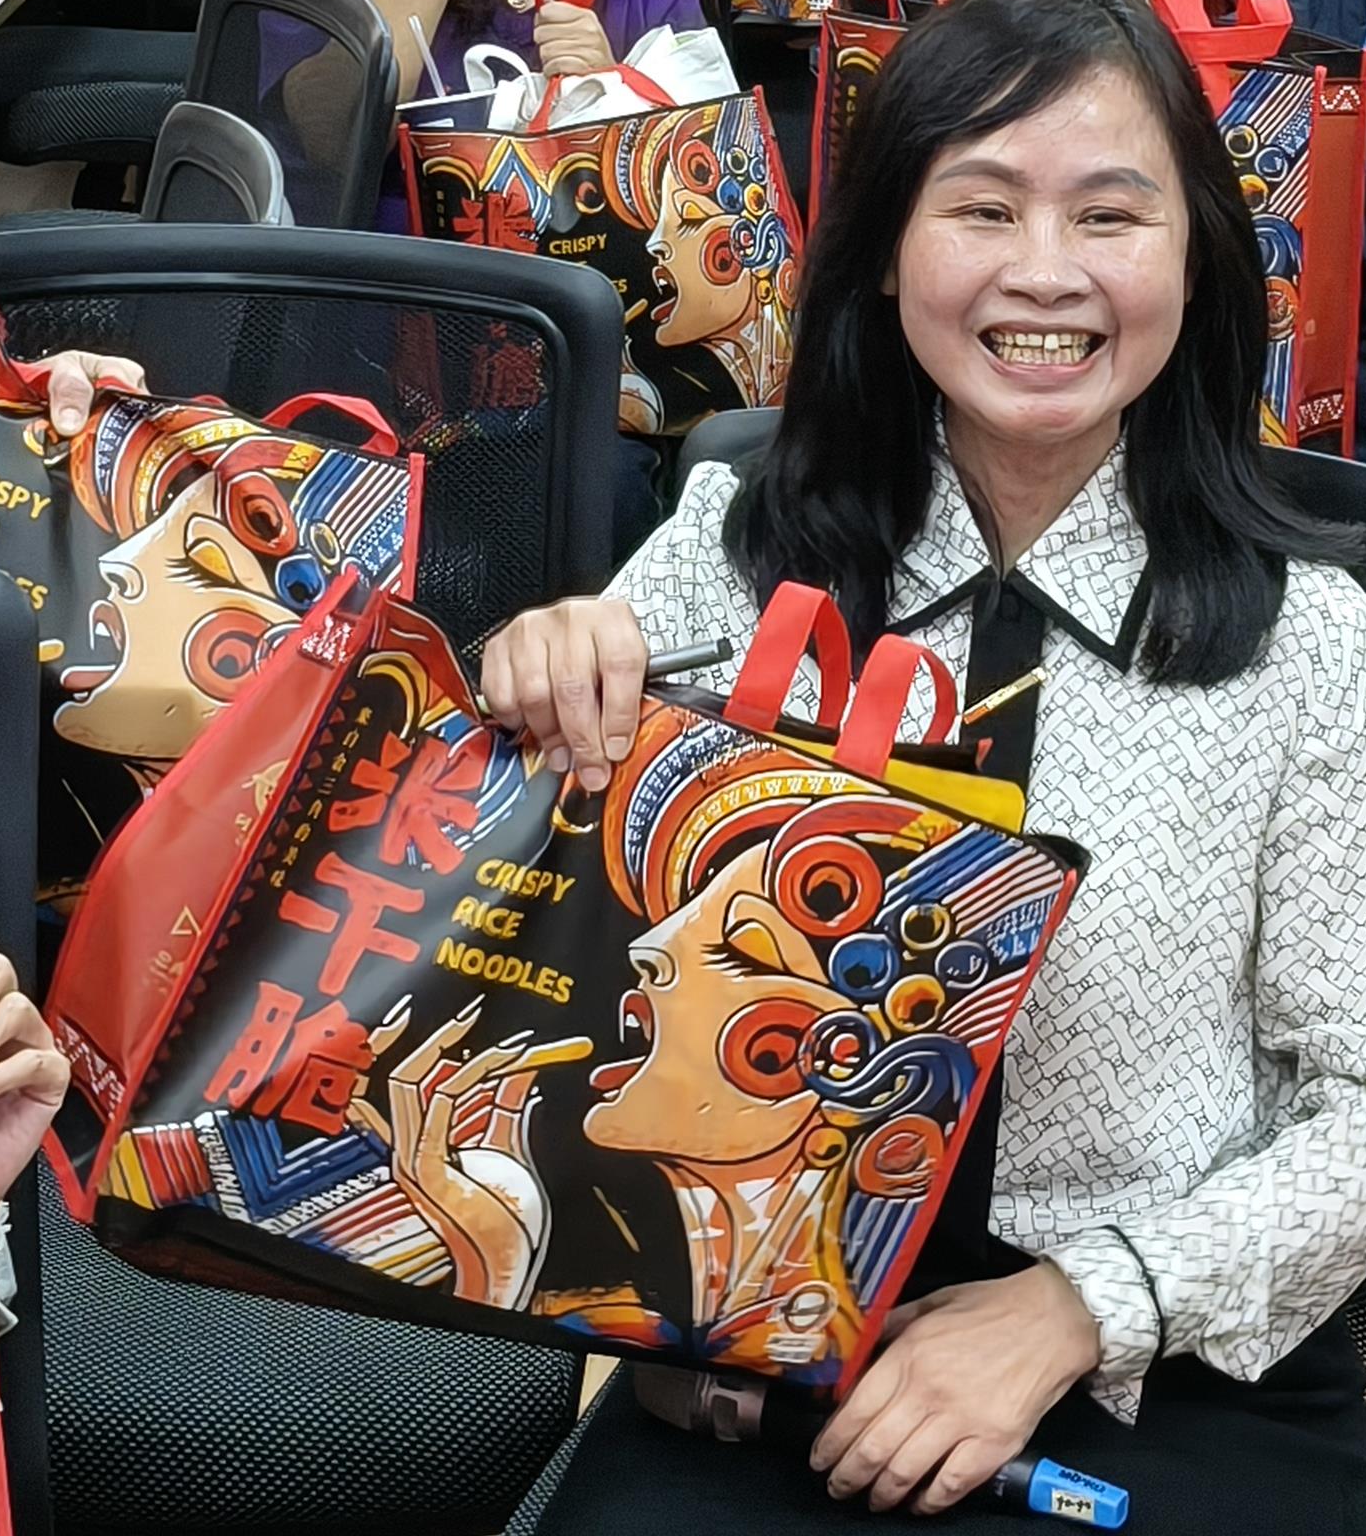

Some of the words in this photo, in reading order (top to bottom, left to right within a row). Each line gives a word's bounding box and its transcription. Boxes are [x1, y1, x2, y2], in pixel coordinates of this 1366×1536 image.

[549, 233, 607, 255] CRISPY
[475, 858, 575, 903] CRISPY
[204, 726, 491, 1135] 米干脆
[451, 895, 522, 939] RICE
[436, 937, 575, 1005] NOODLES
